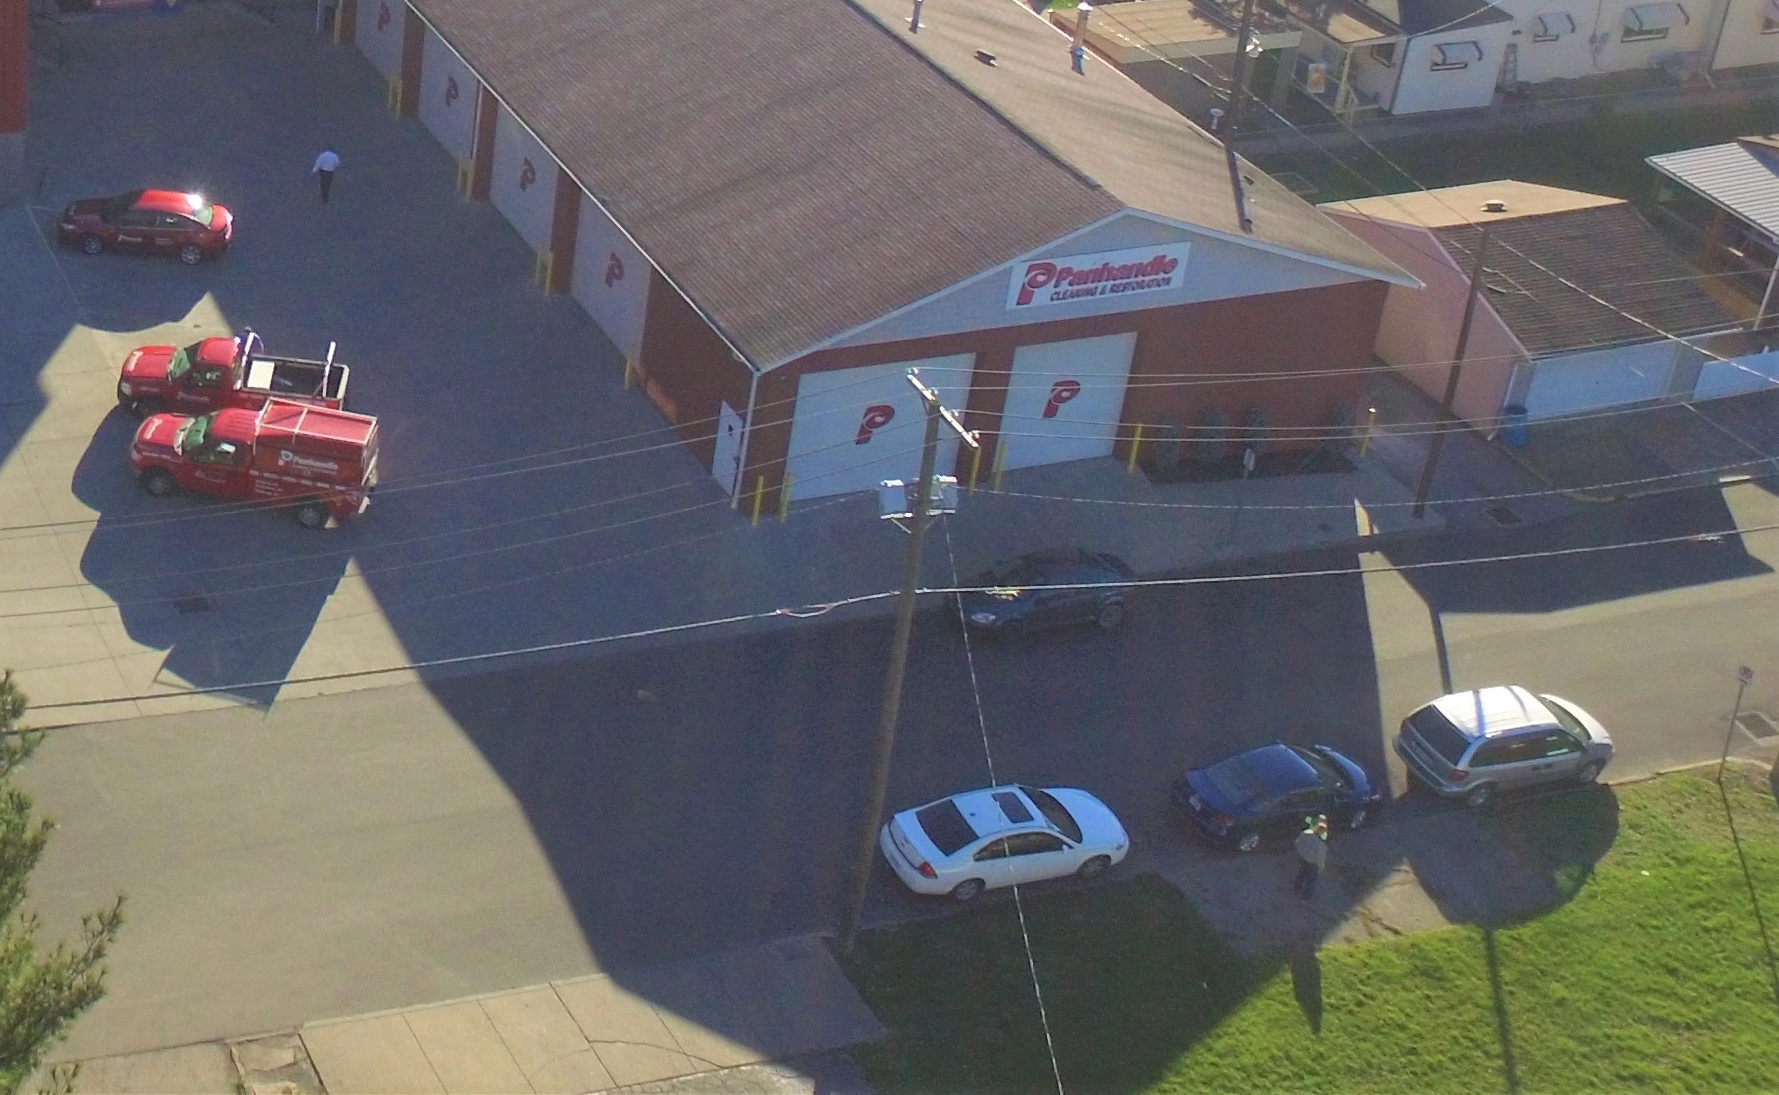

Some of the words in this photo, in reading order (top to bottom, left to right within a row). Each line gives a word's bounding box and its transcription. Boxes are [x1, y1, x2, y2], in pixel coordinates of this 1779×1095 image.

[1053, 254, 1179, 289] Panhandle
[1049, 284, 1098, 302] CLEANING
[1108, 276, 1172, 294] RESTORATION
